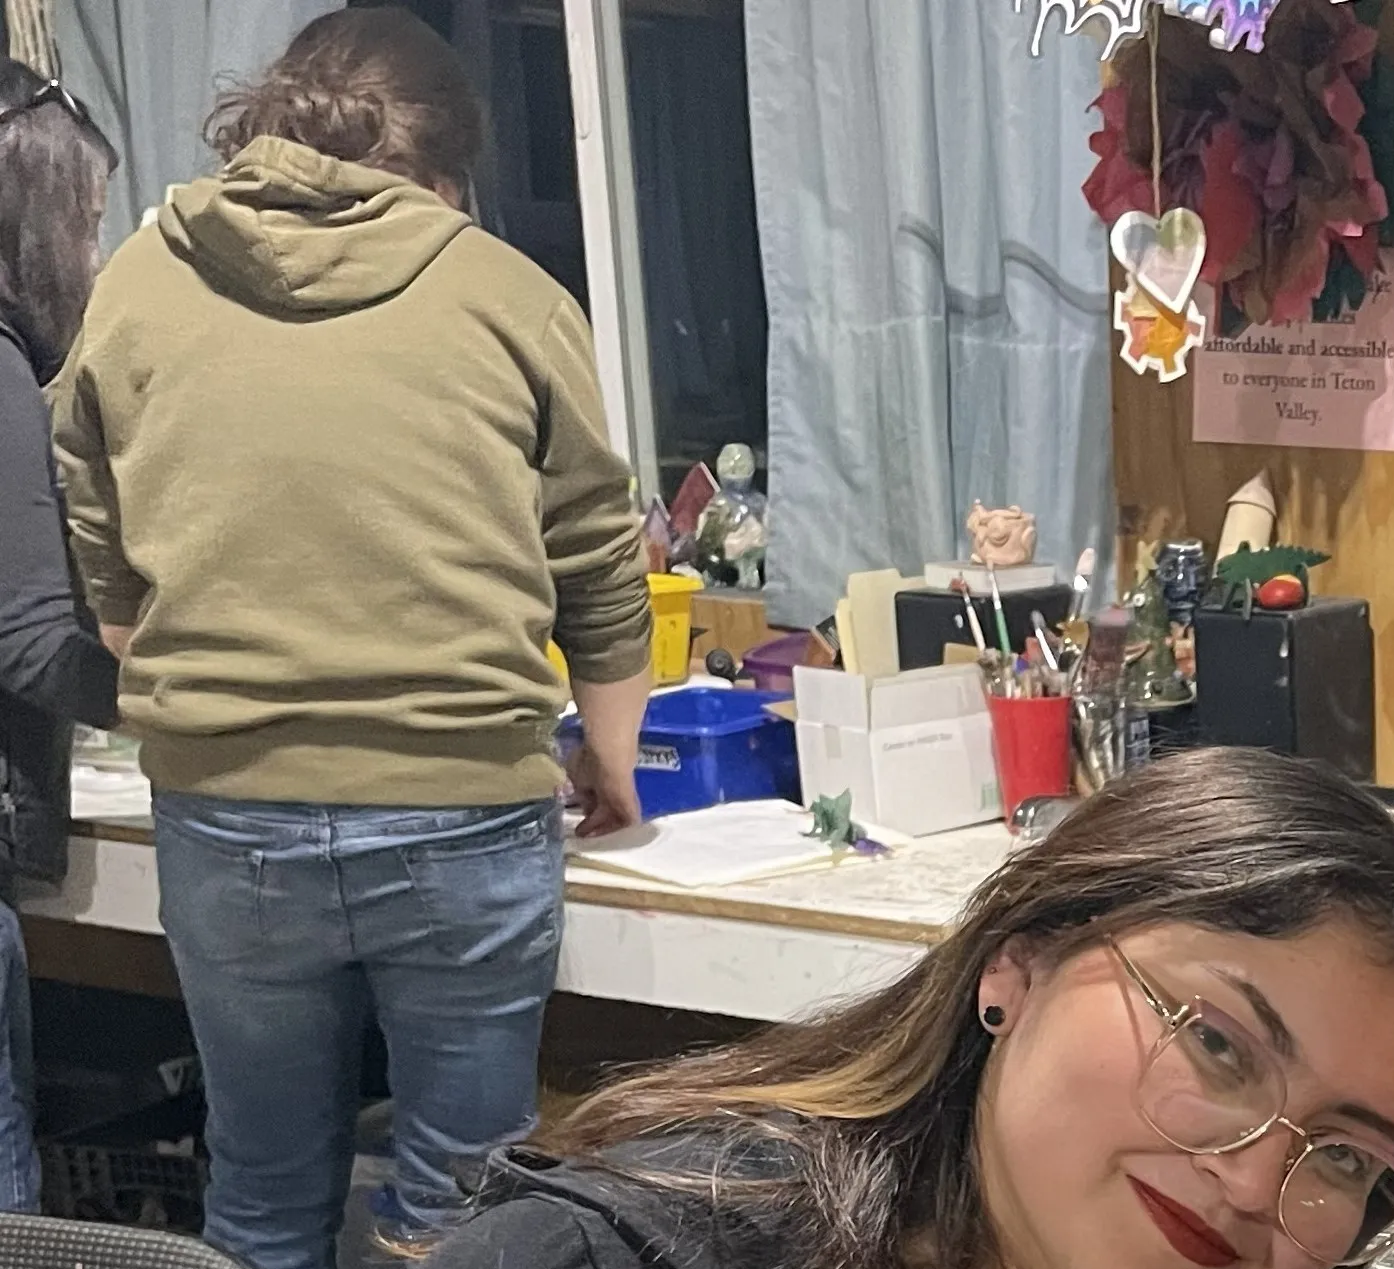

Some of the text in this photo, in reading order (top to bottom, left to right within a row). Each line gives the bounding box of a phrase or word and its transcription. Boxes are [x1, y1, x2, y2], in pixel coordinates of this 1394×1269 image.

[1204, 336, 1394, 359] affordable and accessible
[1223, 372, 1376, 393] to everyone in Teton
[1275, 402, 1322, 426] Valley.
